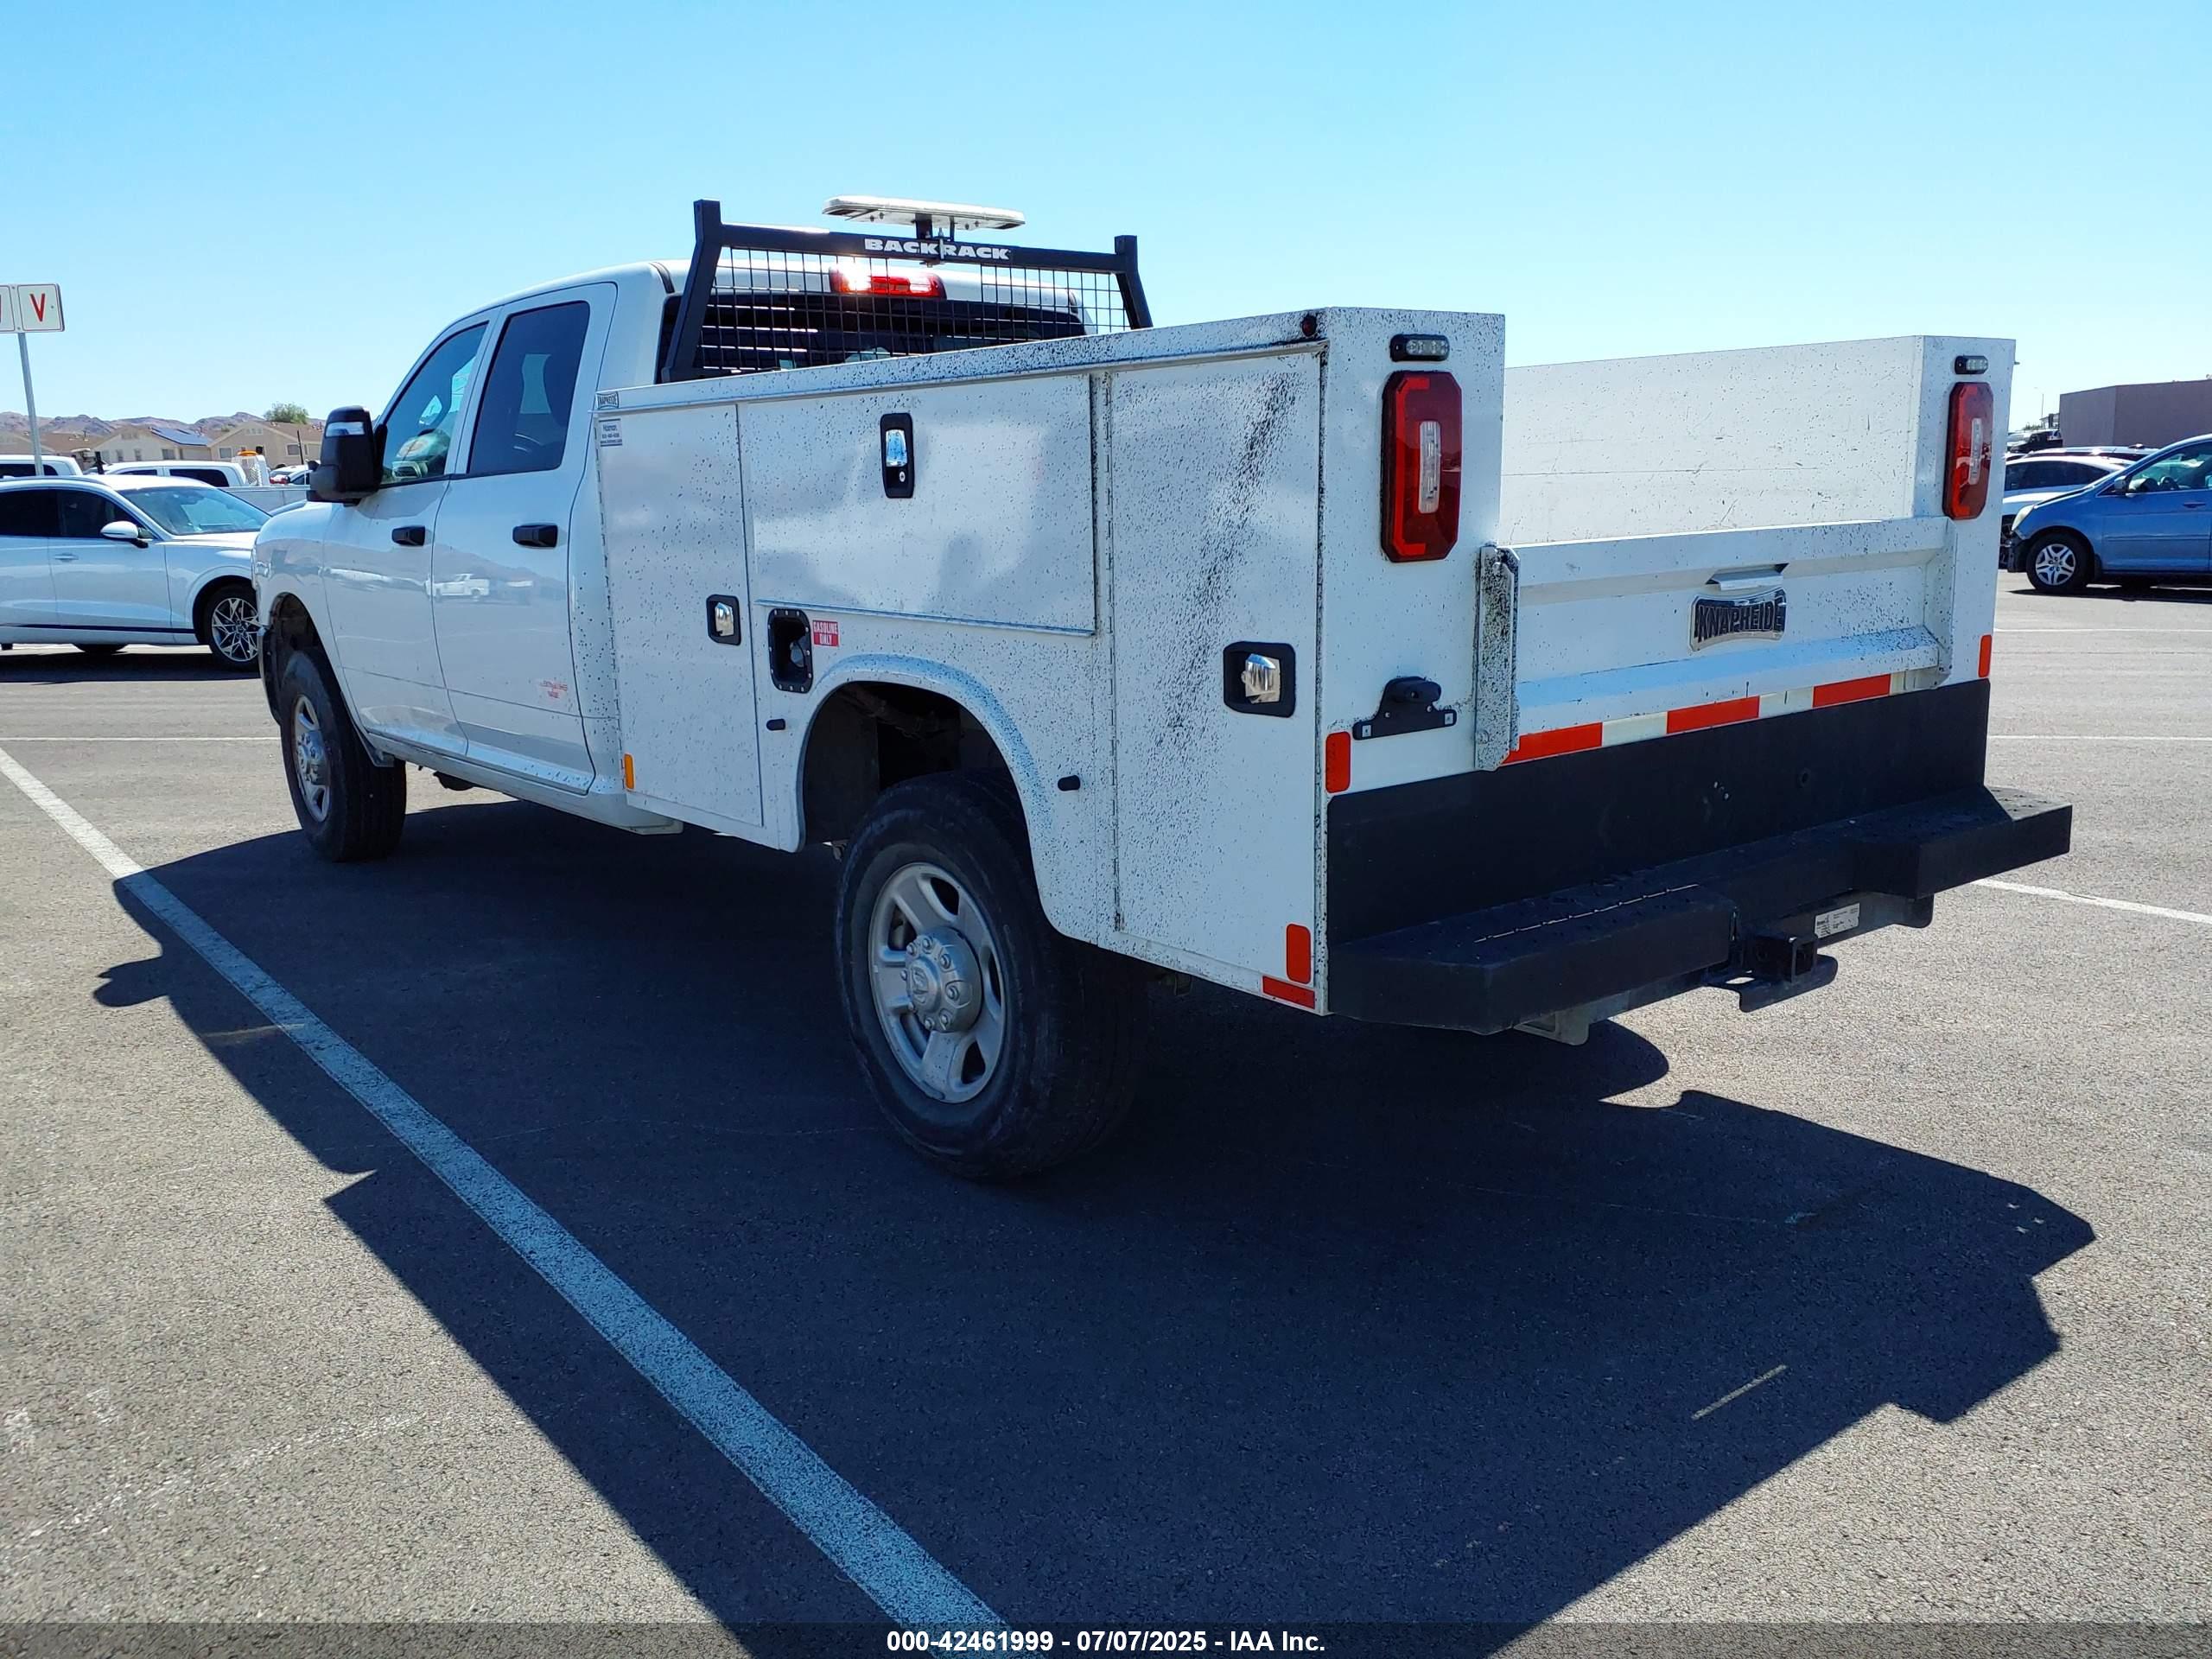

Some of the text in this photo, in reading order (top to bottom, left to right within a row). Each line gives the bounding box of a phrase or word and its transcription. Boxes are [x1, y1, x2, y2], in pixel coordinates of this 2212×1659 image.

[865, 238, 1009, 259] BACKRACK
[29, 293, 46, 322] V
[813, 621, 838, 633] GASOLINE
[1694, 594, 1786, 643] KNAPHEIDE
